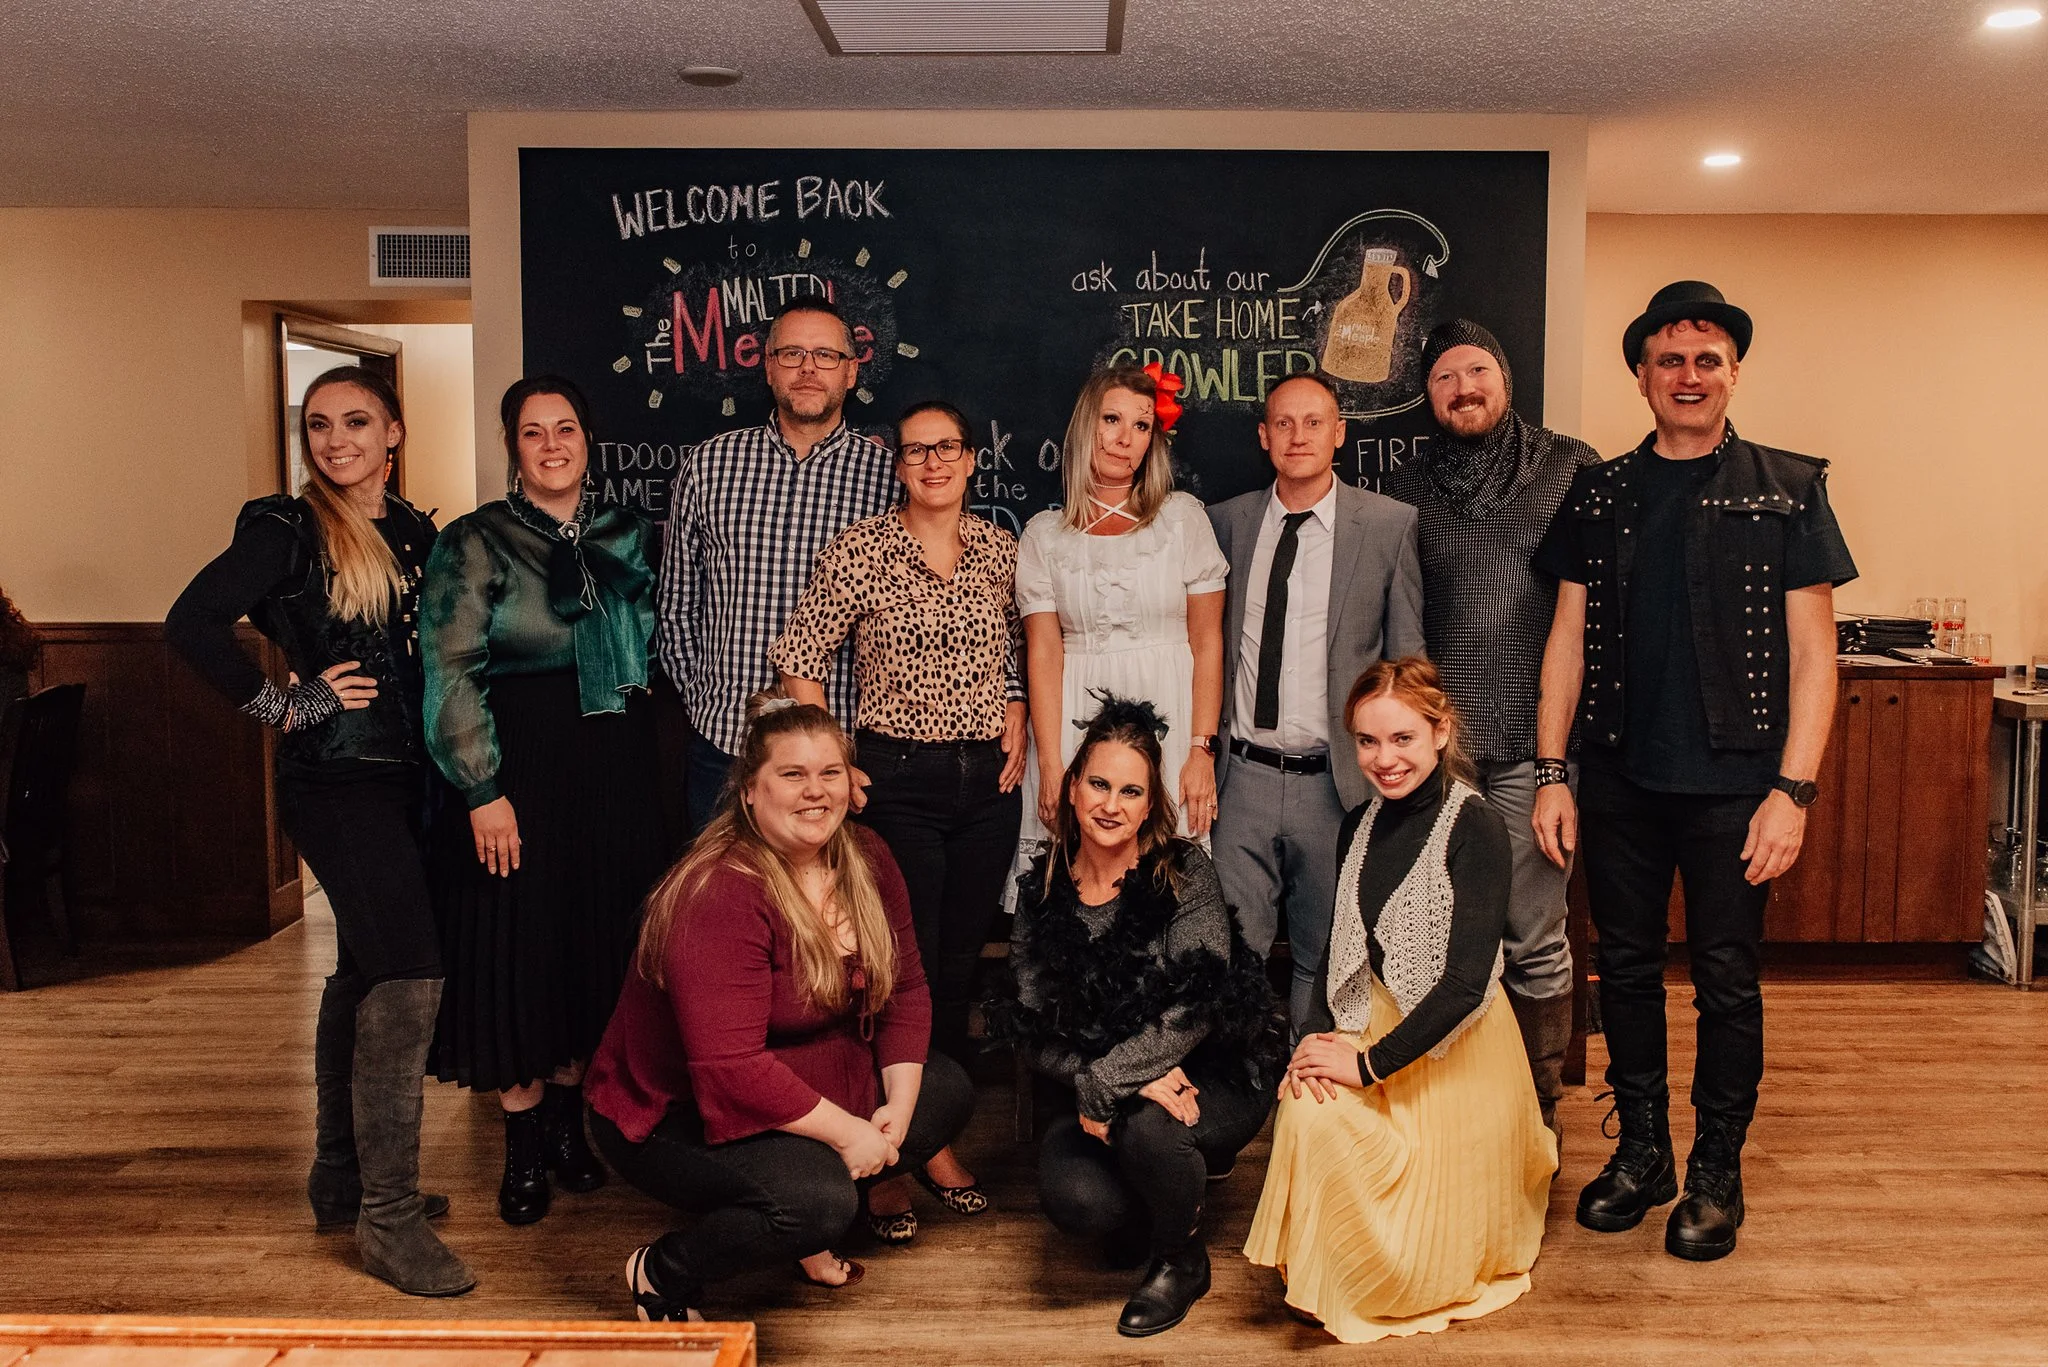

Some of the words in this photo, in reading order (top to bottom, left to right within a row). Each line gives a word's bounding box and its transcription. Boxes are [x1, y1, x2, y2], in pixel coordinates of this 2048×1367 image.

[612, 179, 781, 240] WELCOME
[795, 175, 893, 220] BACK
[728, 234, 758, 260] to
[1071, 260, 1117, 293] ask
[1135, 246, 1212, 292] about
[1226, 269, 1271, 293] our
[672, 279, 875, 375] Mee
[1121, 300, 1205, 340] TAKE
[1215, 297, 1301, 340] HOME
[645, 317, 672, 375] The
[597, 441, 697, 472] TDOO
[974, 474, 1028, 501] the
